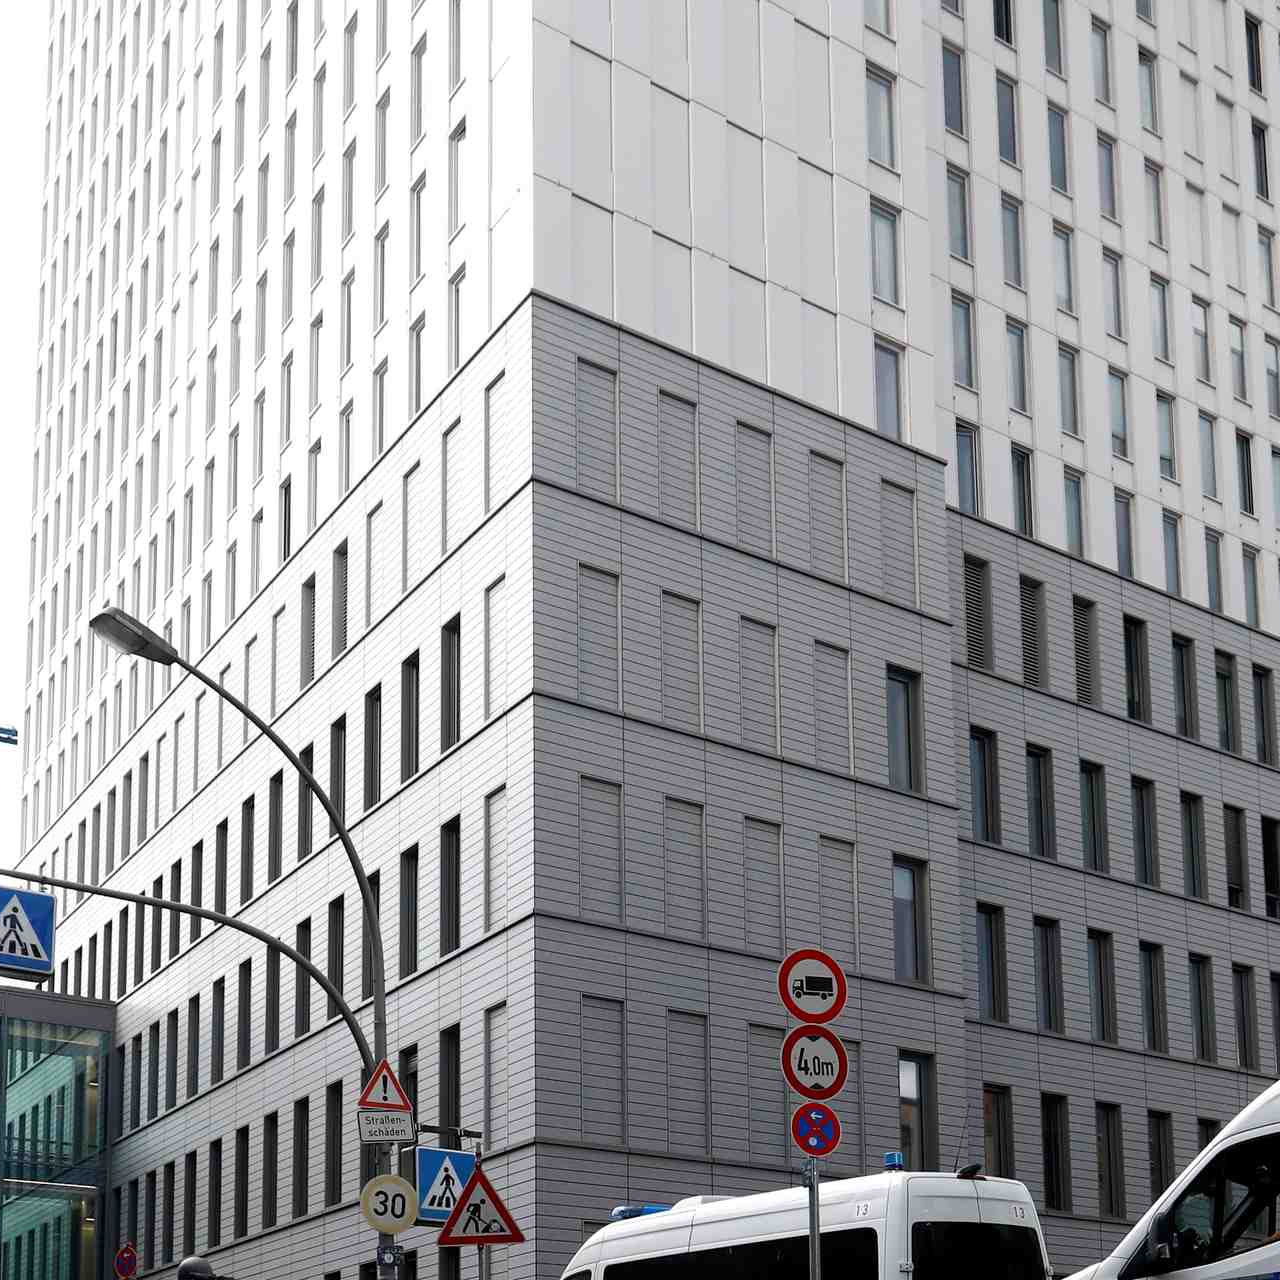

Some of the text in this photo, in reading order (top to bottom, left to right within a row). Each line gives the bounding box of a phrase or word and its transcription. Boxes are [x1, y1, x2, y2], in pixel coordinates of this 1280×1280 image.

[368, 1127, 406, 1137] schäden
[373, 1190, 406, 1219] 30
[856, 1204, 869, 1217] 13
